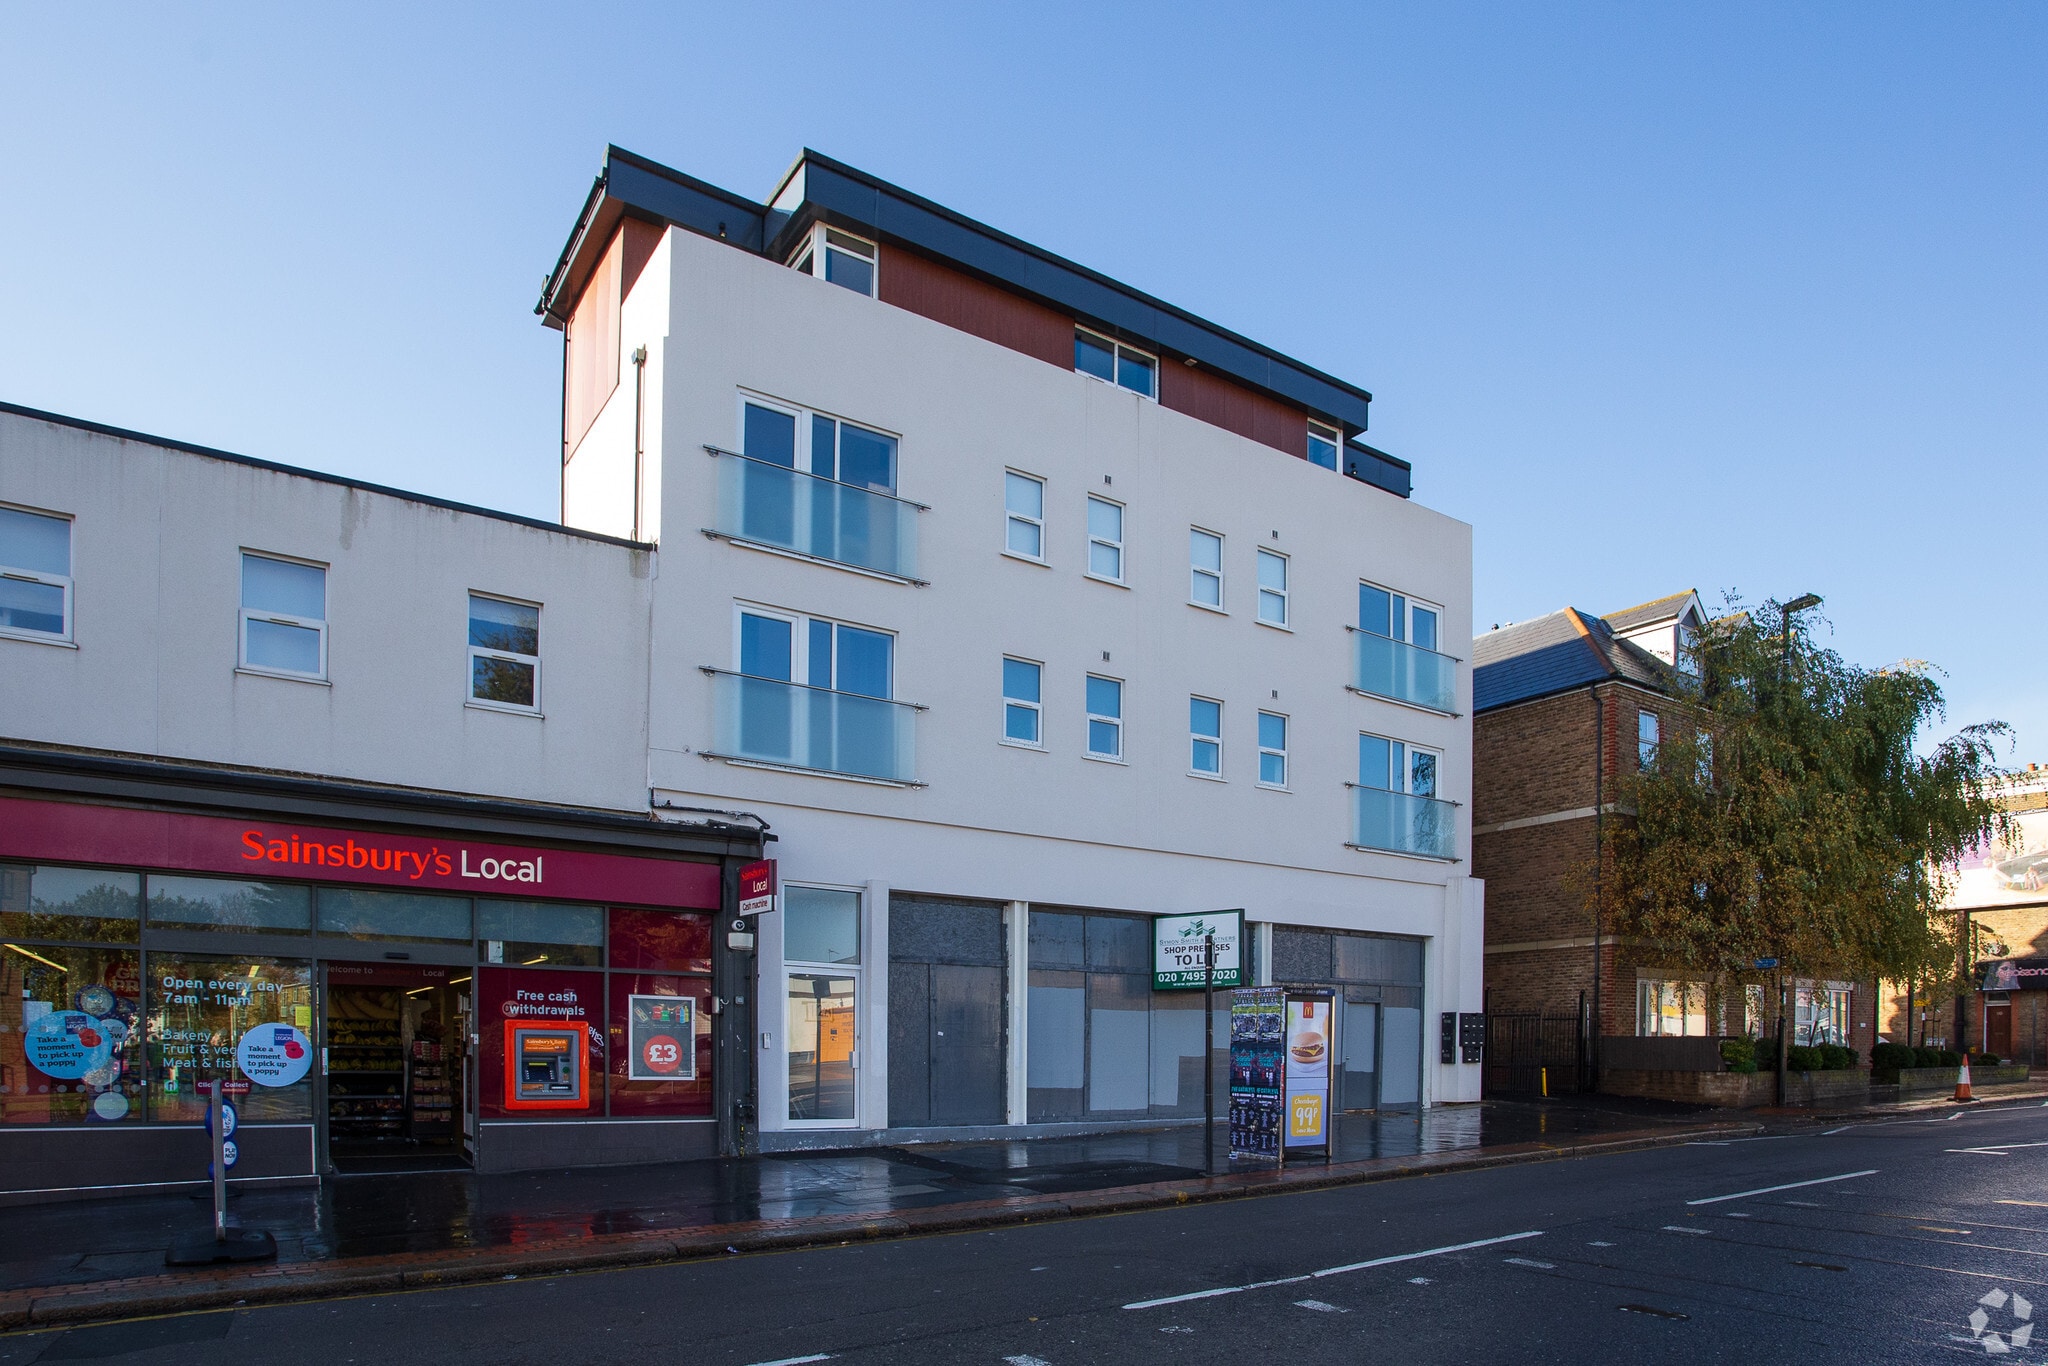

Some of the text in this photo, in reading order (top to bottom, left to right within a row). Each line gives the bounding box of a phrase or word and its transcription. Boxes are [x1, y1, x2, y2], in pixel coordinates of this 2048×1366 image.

[241, 830, 543, 883] Sainsbury's Local
[752, 877, 768, 893] Local
[743, 899, 768, 911] Cash machine
[1164, 943, 1231, 954] SHOP PRESES
[1174, 953, 1220, 966] TO LT
[327, 965, 362, 975] elcome
[363, 966, 374, 975] to
[422, 969, 445, 977] Local
[1158, 969, 1238, 983] 020 7495 7020
[162, 976, 284, 994] Open every day
[162, 992, 198, 1004] 7am
[215, 993, 251, 1007] 11pm
[517, 990, 577, 1002] Free cash
[509, 1004, 585, 1016] withdrawals
[162, 1030, 211, 1043] Bakery
[37, 1043, 76, 1051] moment
[162, 1043, 195, 1054] Fruit
[199, 1044, 210, 1054] &
[50, 1051, 71, 1060] pick
[649, 1044, 678, 1063] £3
[47, 1060, 76, 1068] poppy
[162, 1057, 197, 1068] Meat
[201, 1058, 212, 1068] &
[258, 1060, 276, 1068] pick
[255, 1068, 280, 1076] poppy
